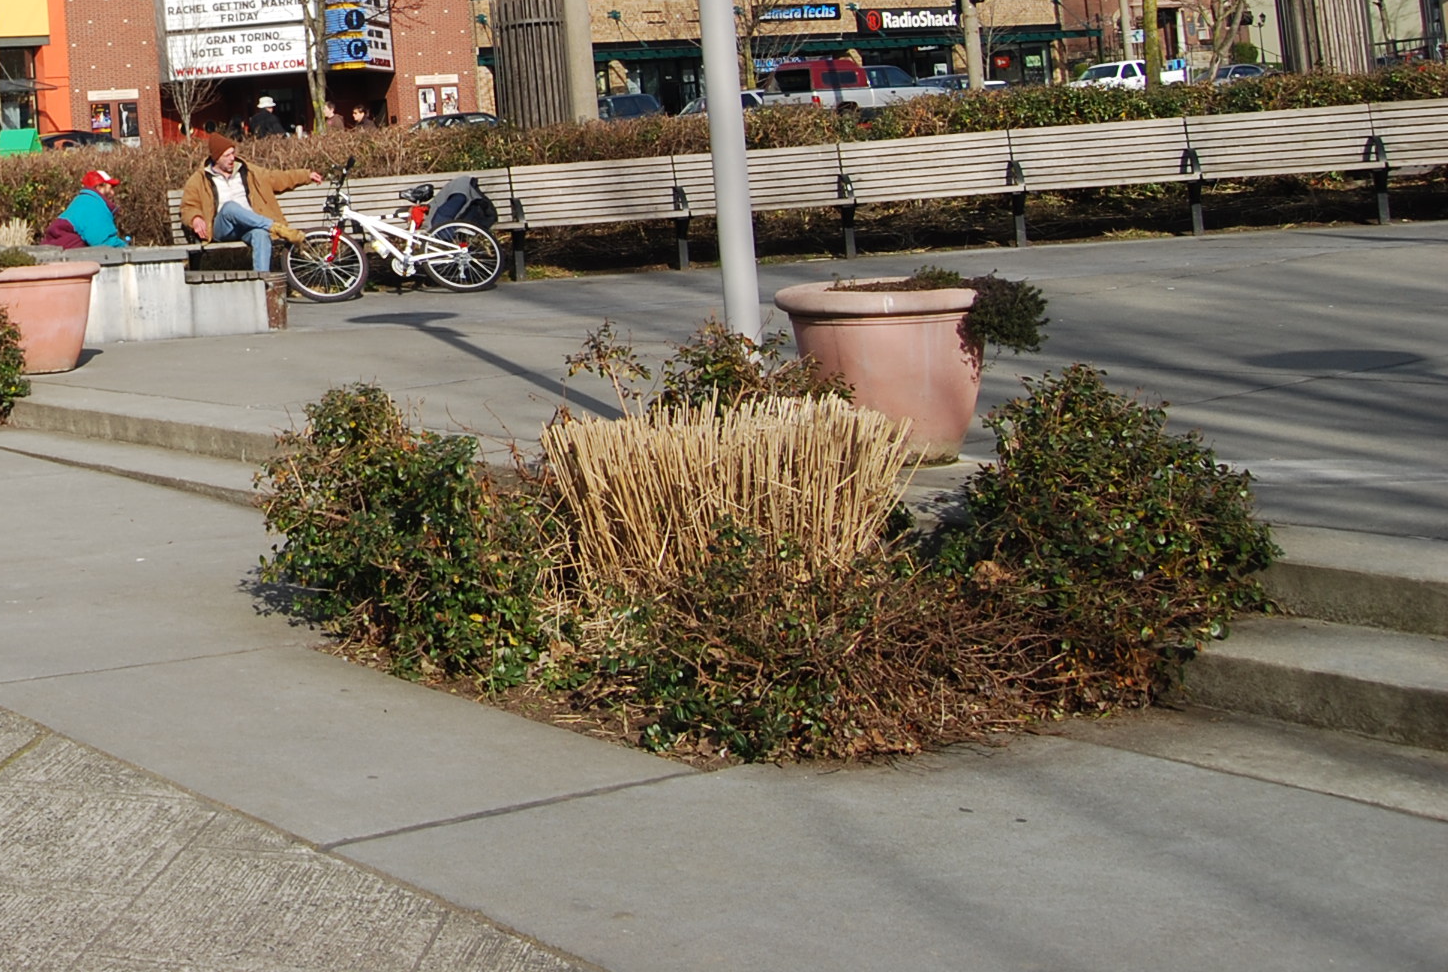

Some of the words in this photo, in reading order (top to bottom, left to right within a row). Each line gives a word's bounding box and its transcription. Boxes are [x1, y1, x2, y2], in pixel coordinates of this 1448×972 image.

[167, 6, 208, 16] RACHEL
[212, 0, 256, 12] GETTING
[758, 7, 802, 20] amera
[802, 5, 836, 19] Techs
[221, 11, 259, 23] FRIDAY
[881, 10, 957, 28] RadioShack
[206, 34, 236, 45] GRAN
[241, 31, 280, 42] TORINO
[192, 47, 224, 58] HOTEL
[232, 45, 253, 55] FOR
[263, 42, 292, 53] DOGS
